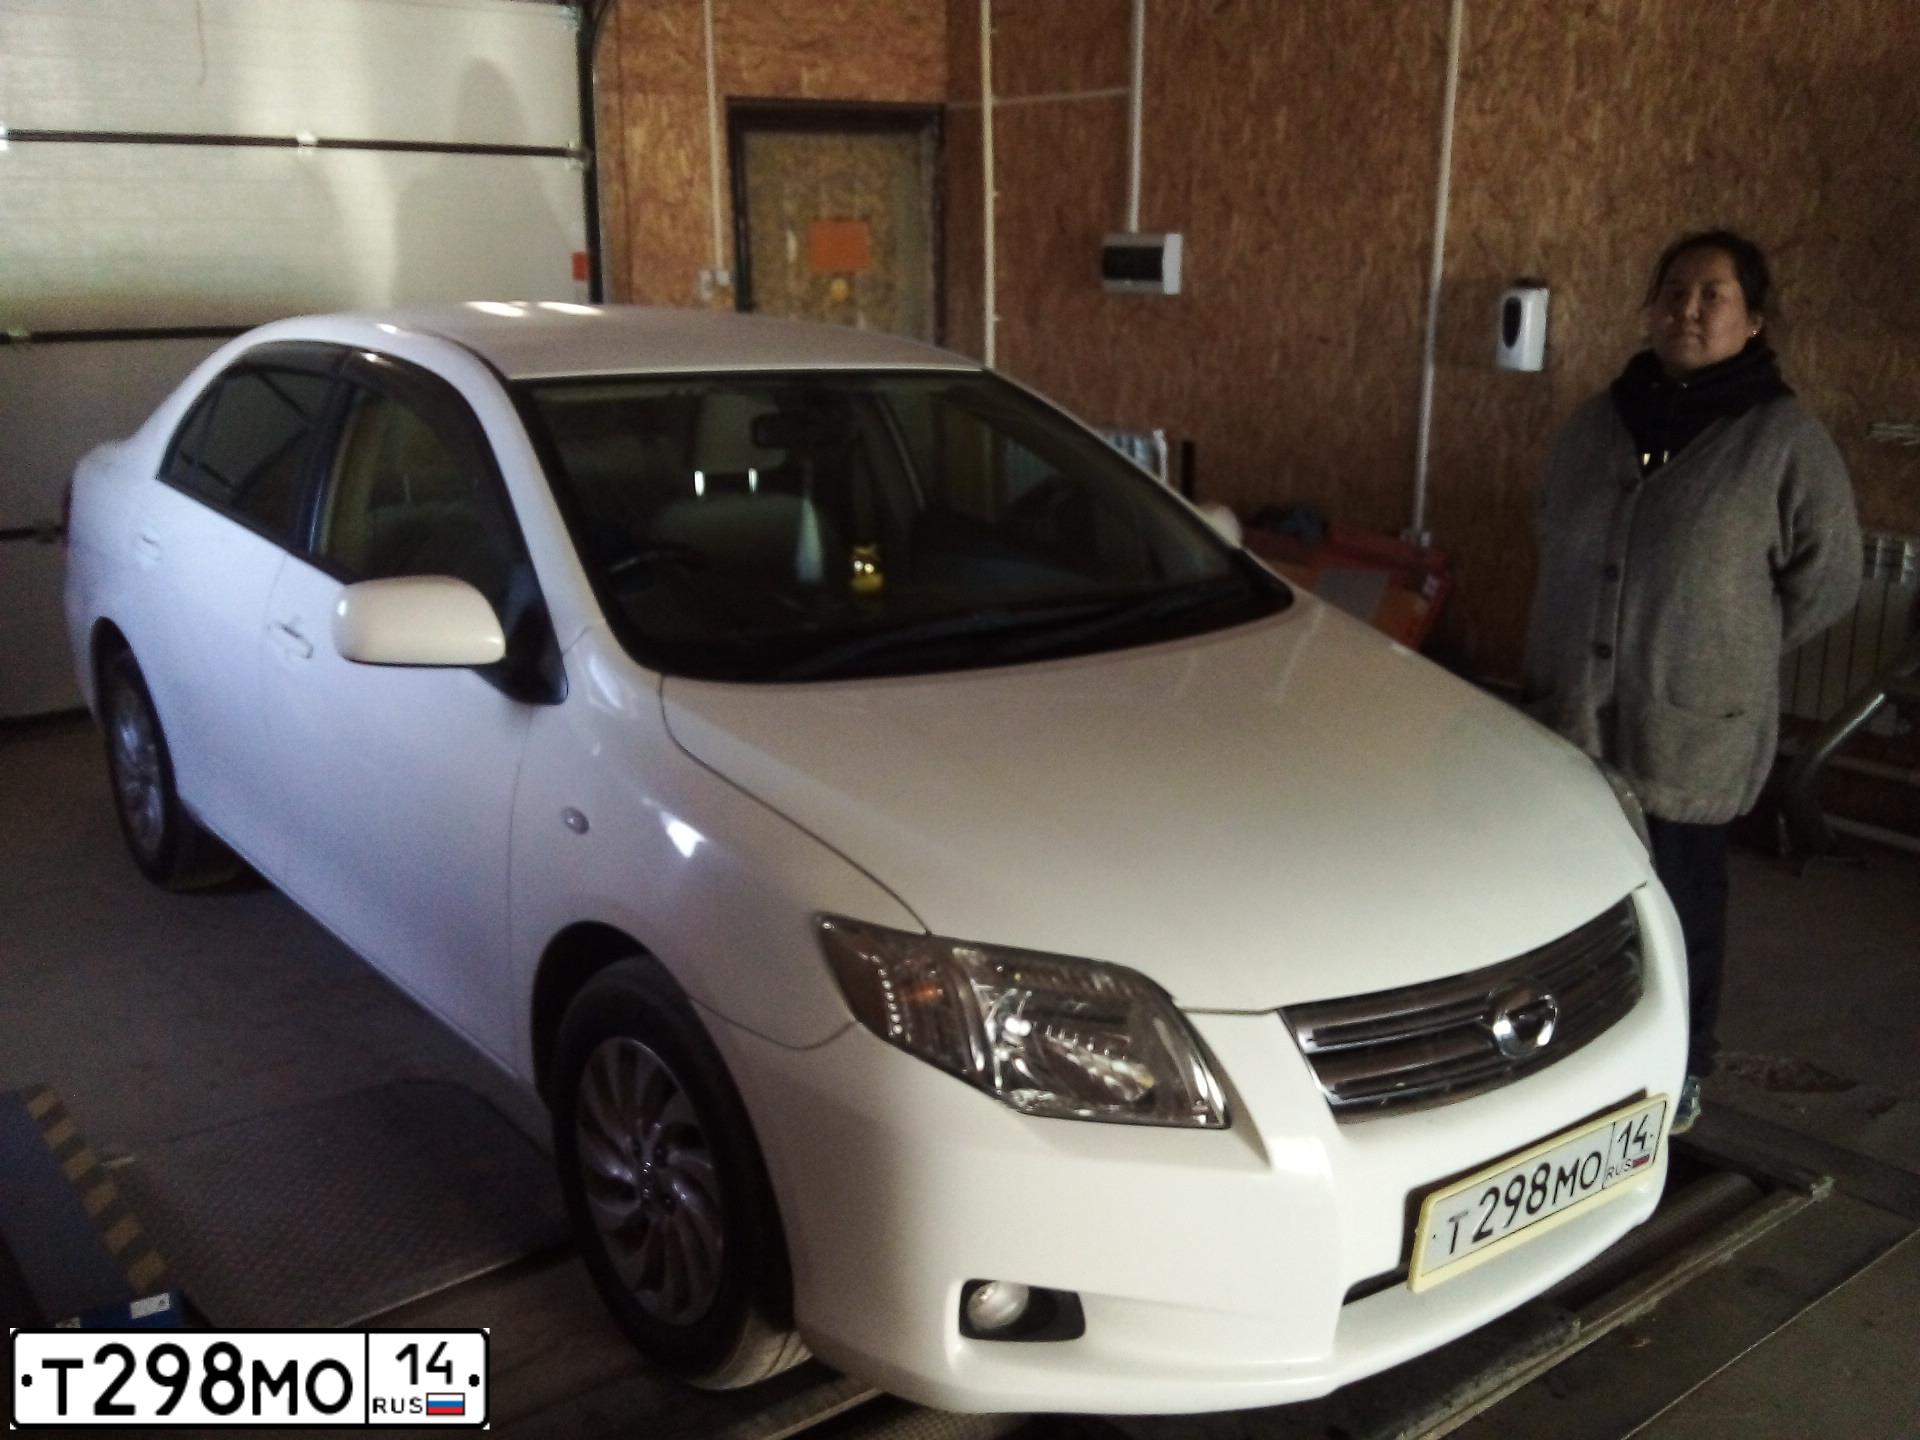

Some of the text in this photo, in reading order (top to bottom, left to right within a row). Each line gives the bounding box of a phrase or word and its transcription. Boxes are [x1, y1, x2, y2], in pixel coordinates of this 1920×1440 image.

[1617, 1113, 1649, 1159] 14
[1606, 1158, 1633, 1180] RUS
[1448, 1151, 1602, 1255] T298MO
